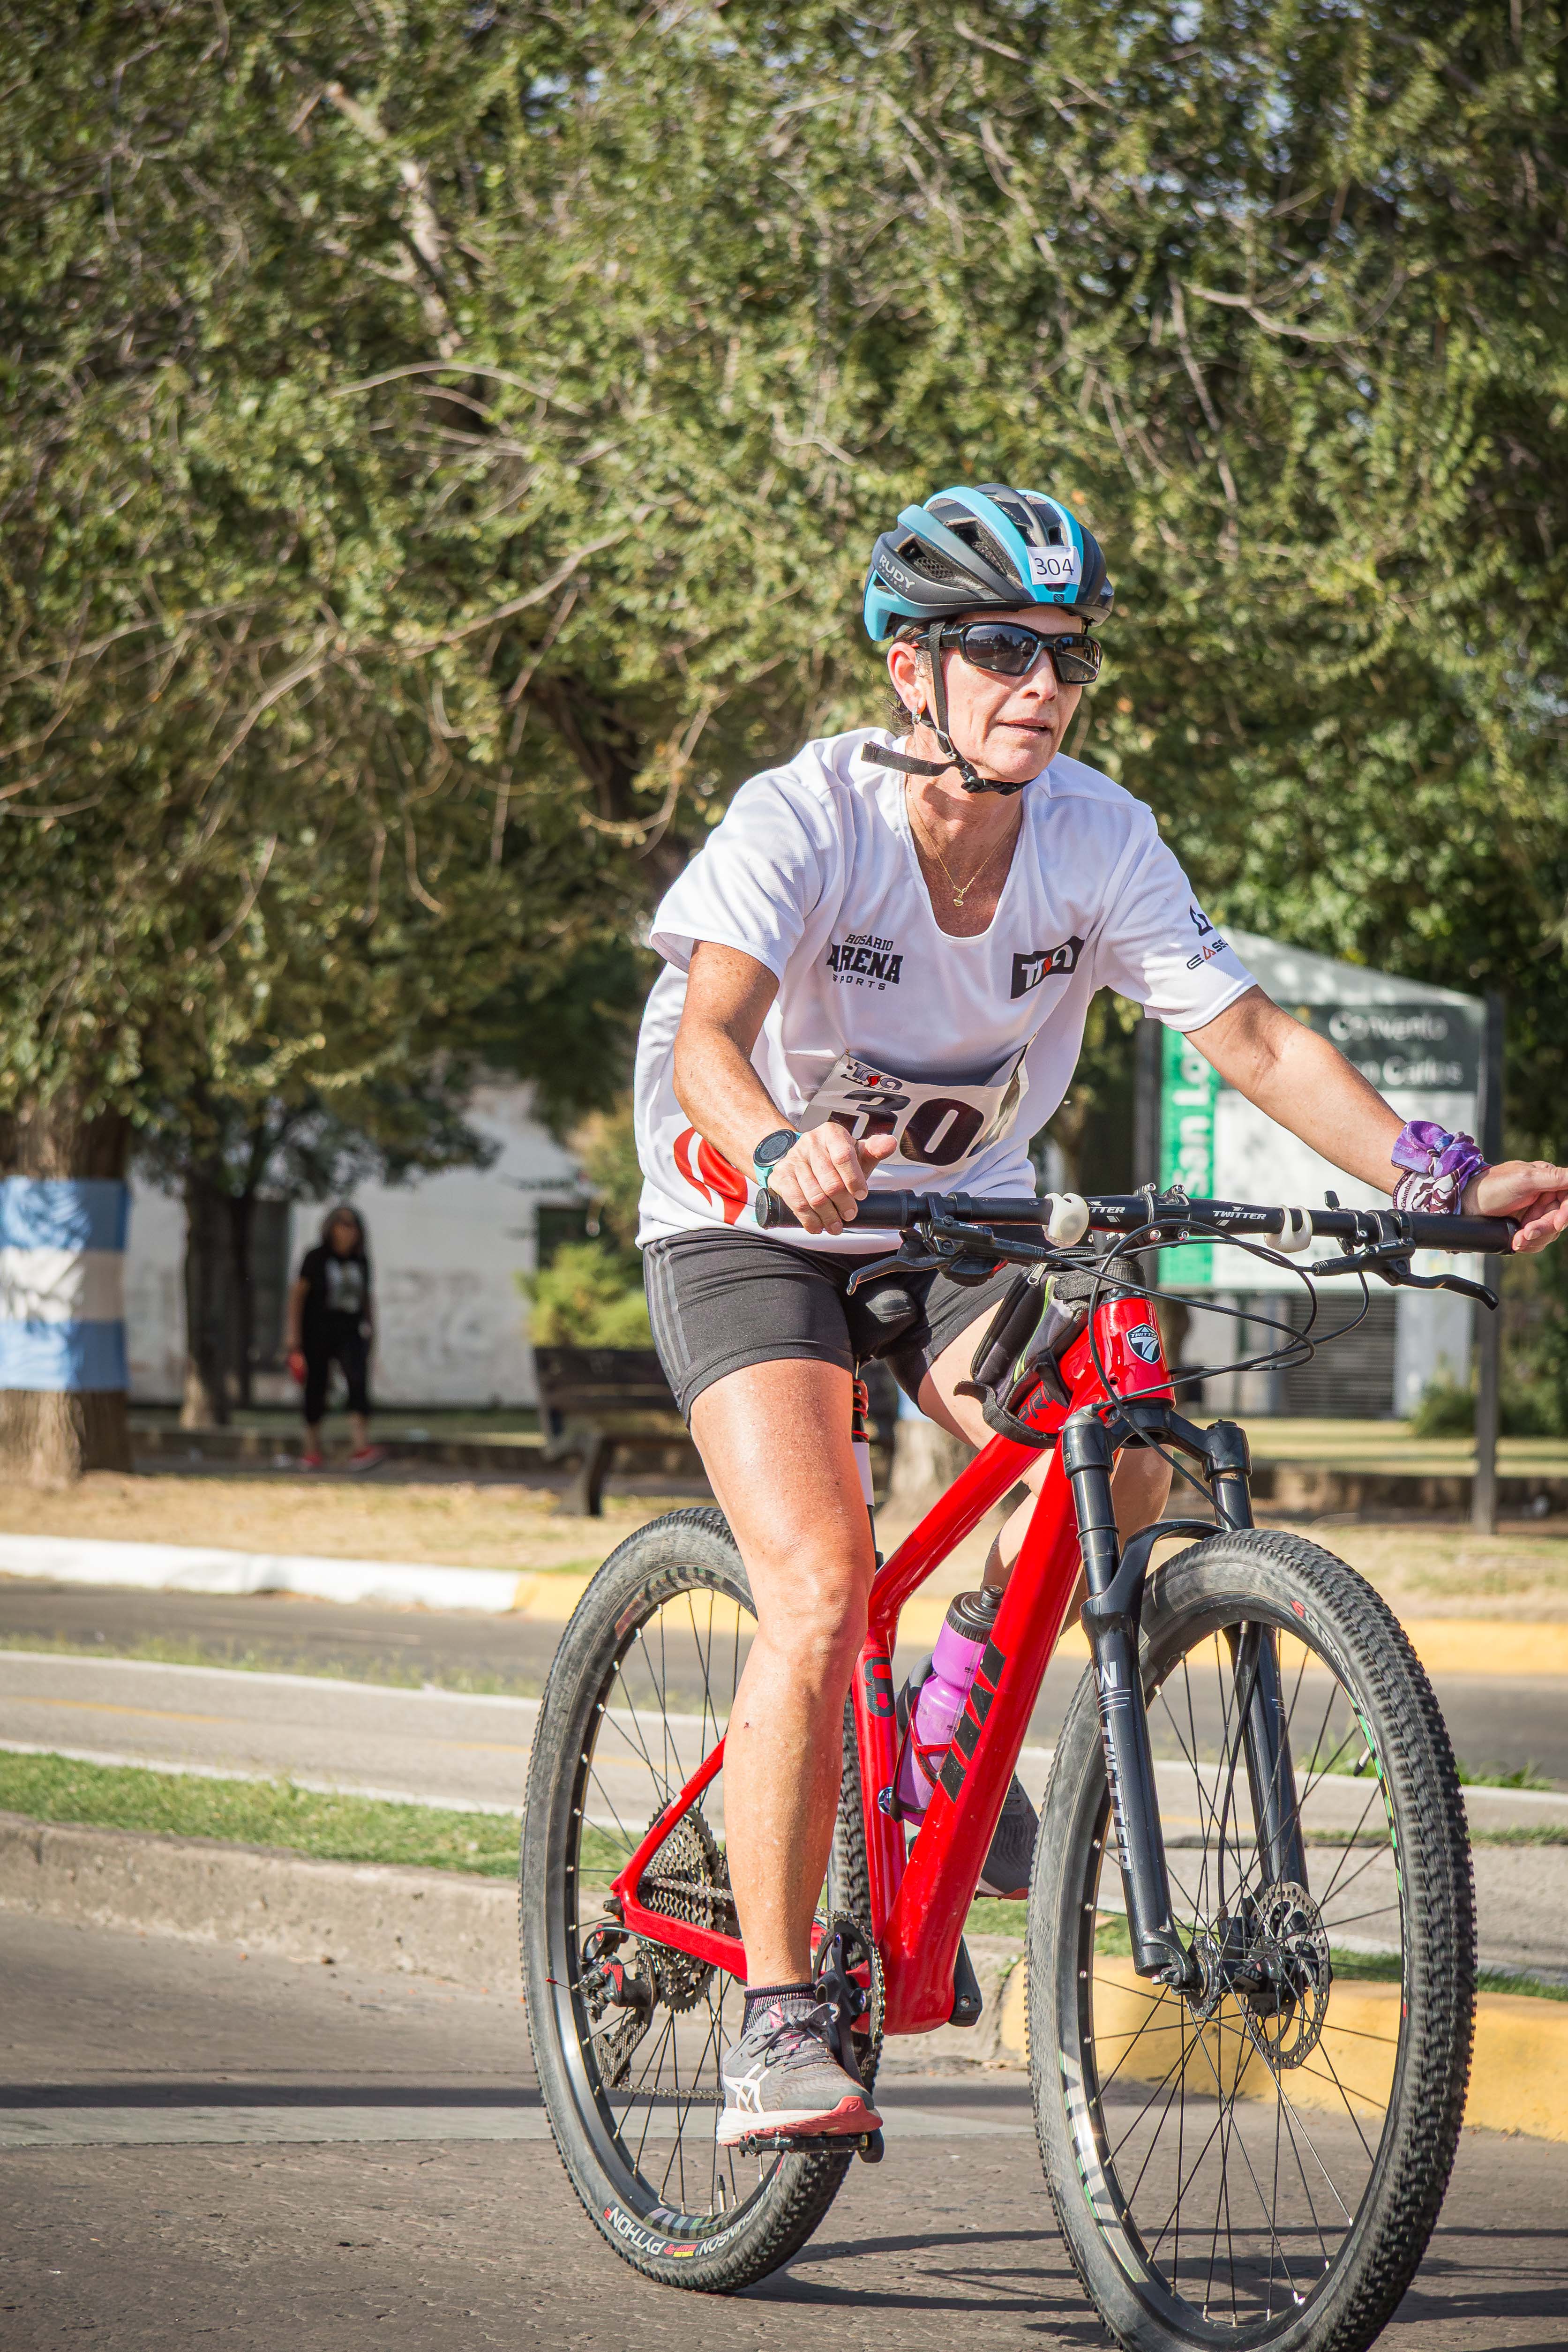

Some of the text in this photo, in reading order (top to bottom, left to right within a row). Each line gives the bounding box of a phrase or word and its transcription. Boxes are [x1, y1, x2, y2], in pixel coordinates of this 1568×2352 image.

[879, 554, 915, 589] RUDY
[1034, 557, 1073, 576] 304
[845, 934, 894, 951] ROSARIO
[825, 943, 904, 985] ARENA
[833, 974, 886, 990] SPORTS
[1401, 1180, 1413, 1207] Columbia
[1212, 1210, 1267, 1220] TWITTER
[1102, 1719, 1132, 1870] TWITTER
[608, 2207, 667, 2255] PYTHON
